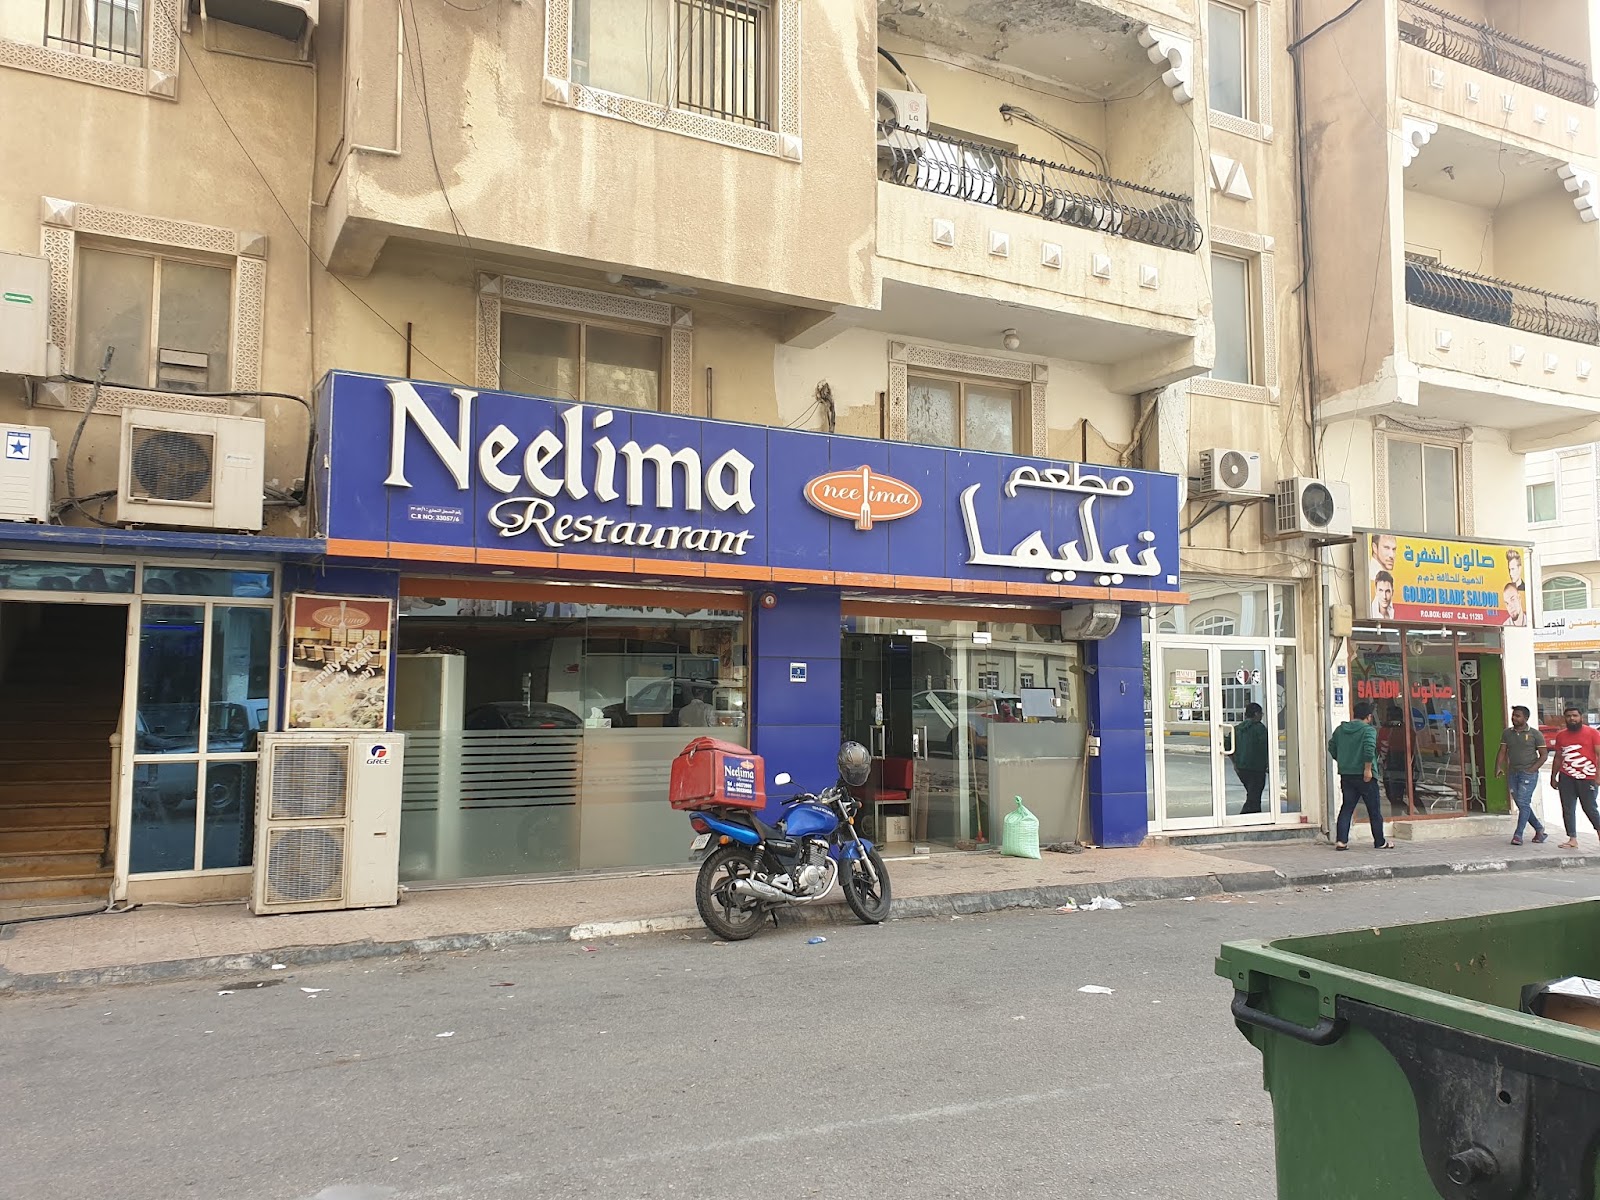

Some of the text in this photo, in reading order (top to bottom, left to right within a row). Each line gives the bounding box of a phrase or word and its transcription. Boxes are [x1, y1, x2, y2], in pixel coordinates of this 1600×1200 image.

[908, 114, 919, 122] LG
[383, 380, 757, 515] Neelima
[1005, 463, 1134, 498] مطعم
[488, 497, 755, 556] Restaurant
[960, 482, 1162, 587] نيليما
[1403, 545, 1495, 572] صالون الشفرة
[1403, 585, 1499, 608] GOLDEN BLADE SALOON
[340, 634, 374, 662] Room
[347, 650, 375, 673] Hall
[1357, 680, 1400, 699] SALOON
[1411, 682, 1453, 704] صالون
